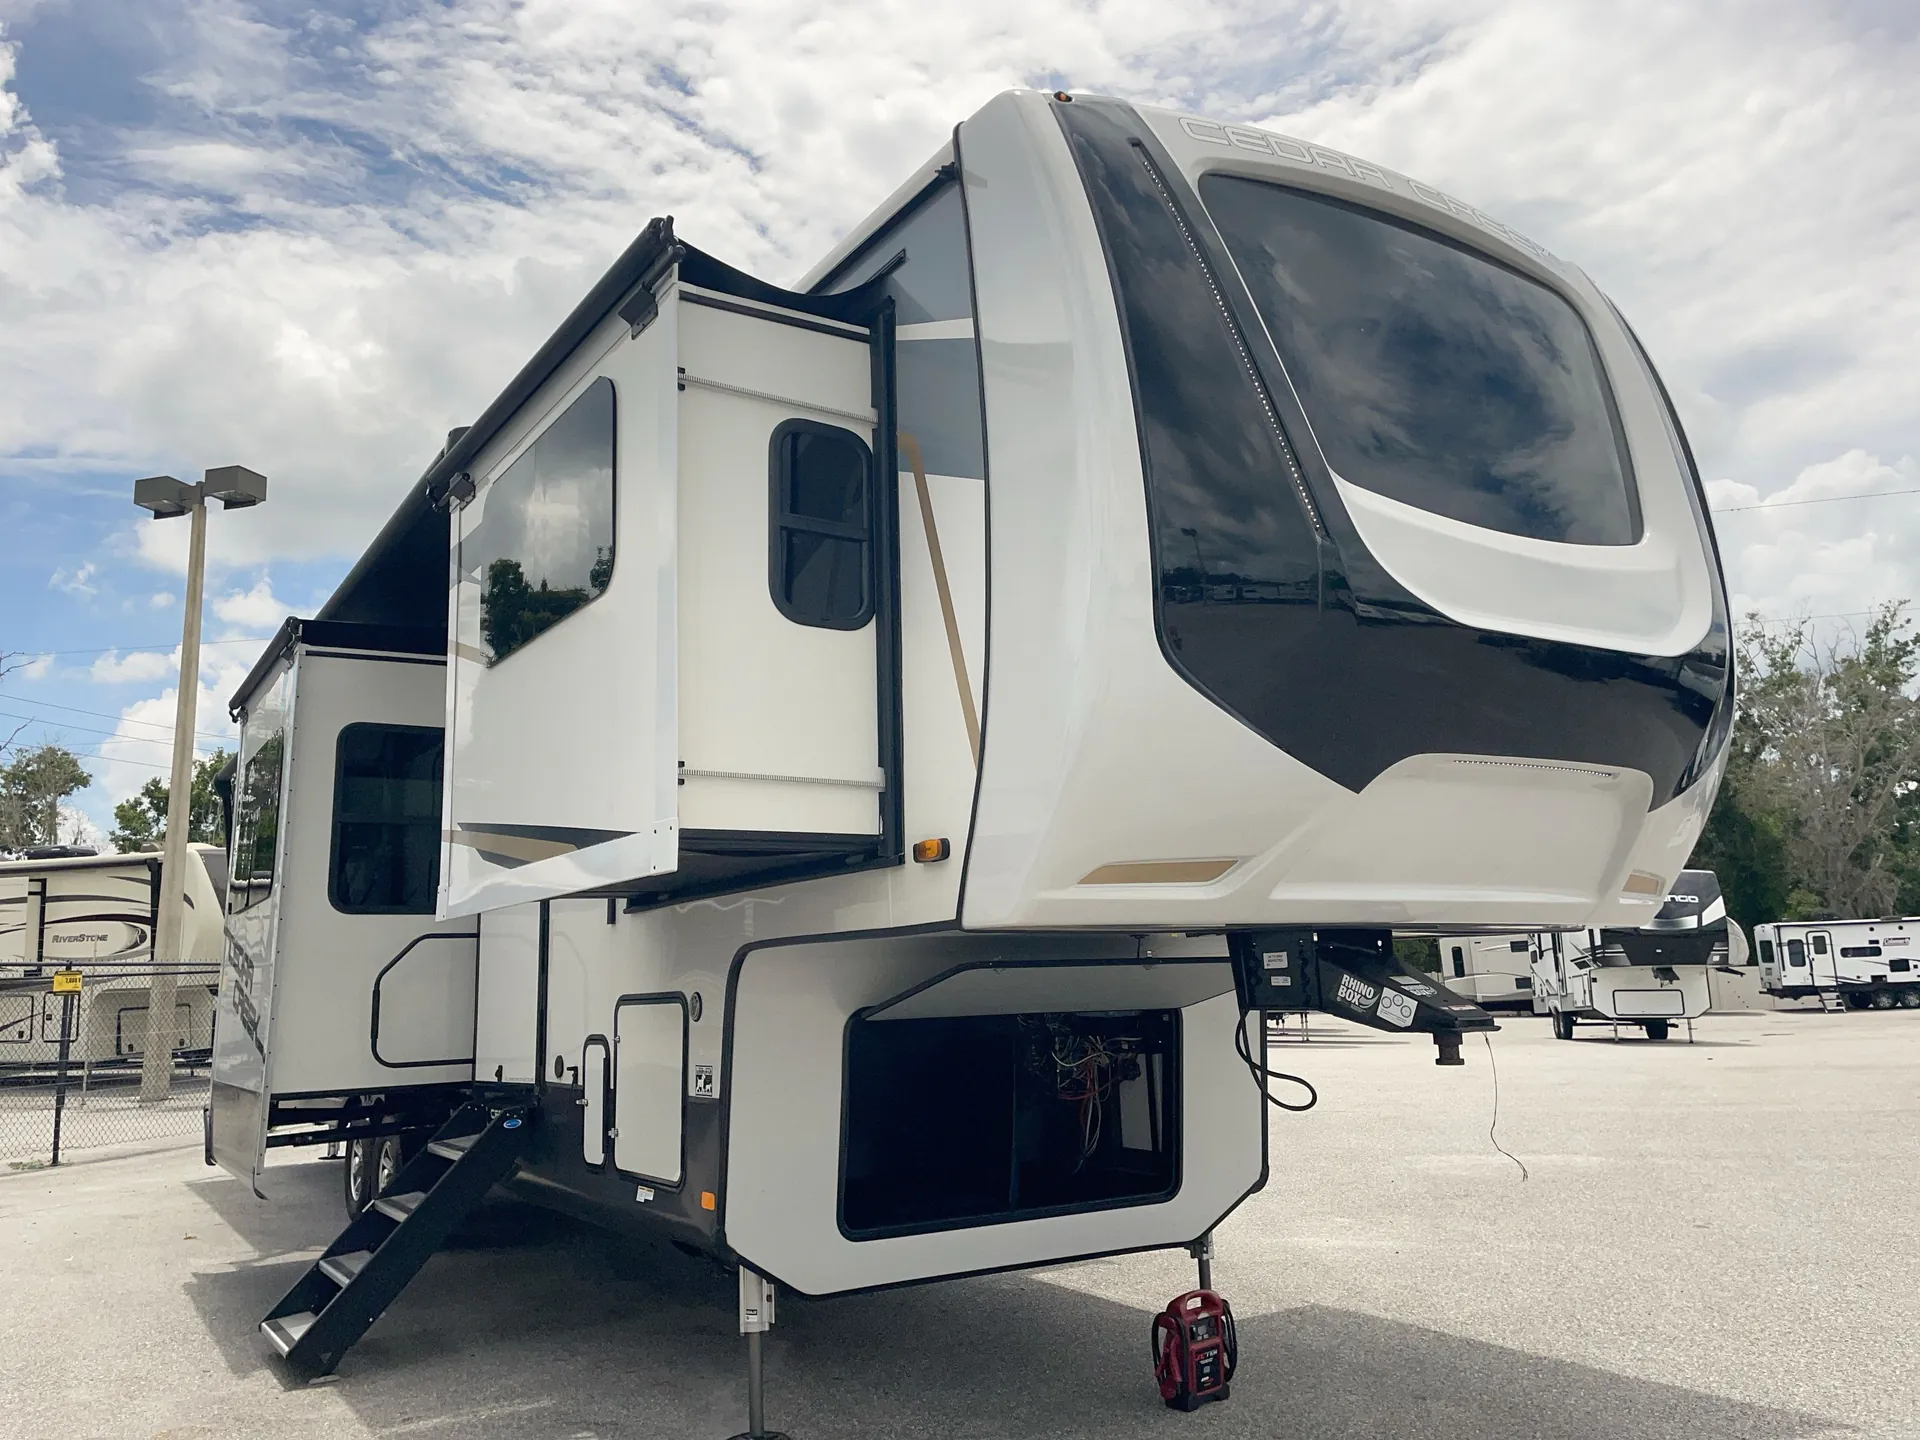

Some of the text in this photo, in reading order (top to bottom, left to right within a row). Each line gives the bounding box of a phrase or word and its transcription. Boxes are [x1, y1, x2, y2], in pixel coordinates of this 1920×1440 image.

[1178, 116, 1393, 189] CEDAR
[1337, 984, 1362, 1005] BOX
[1341, 973, 1374, 998] RHINO
